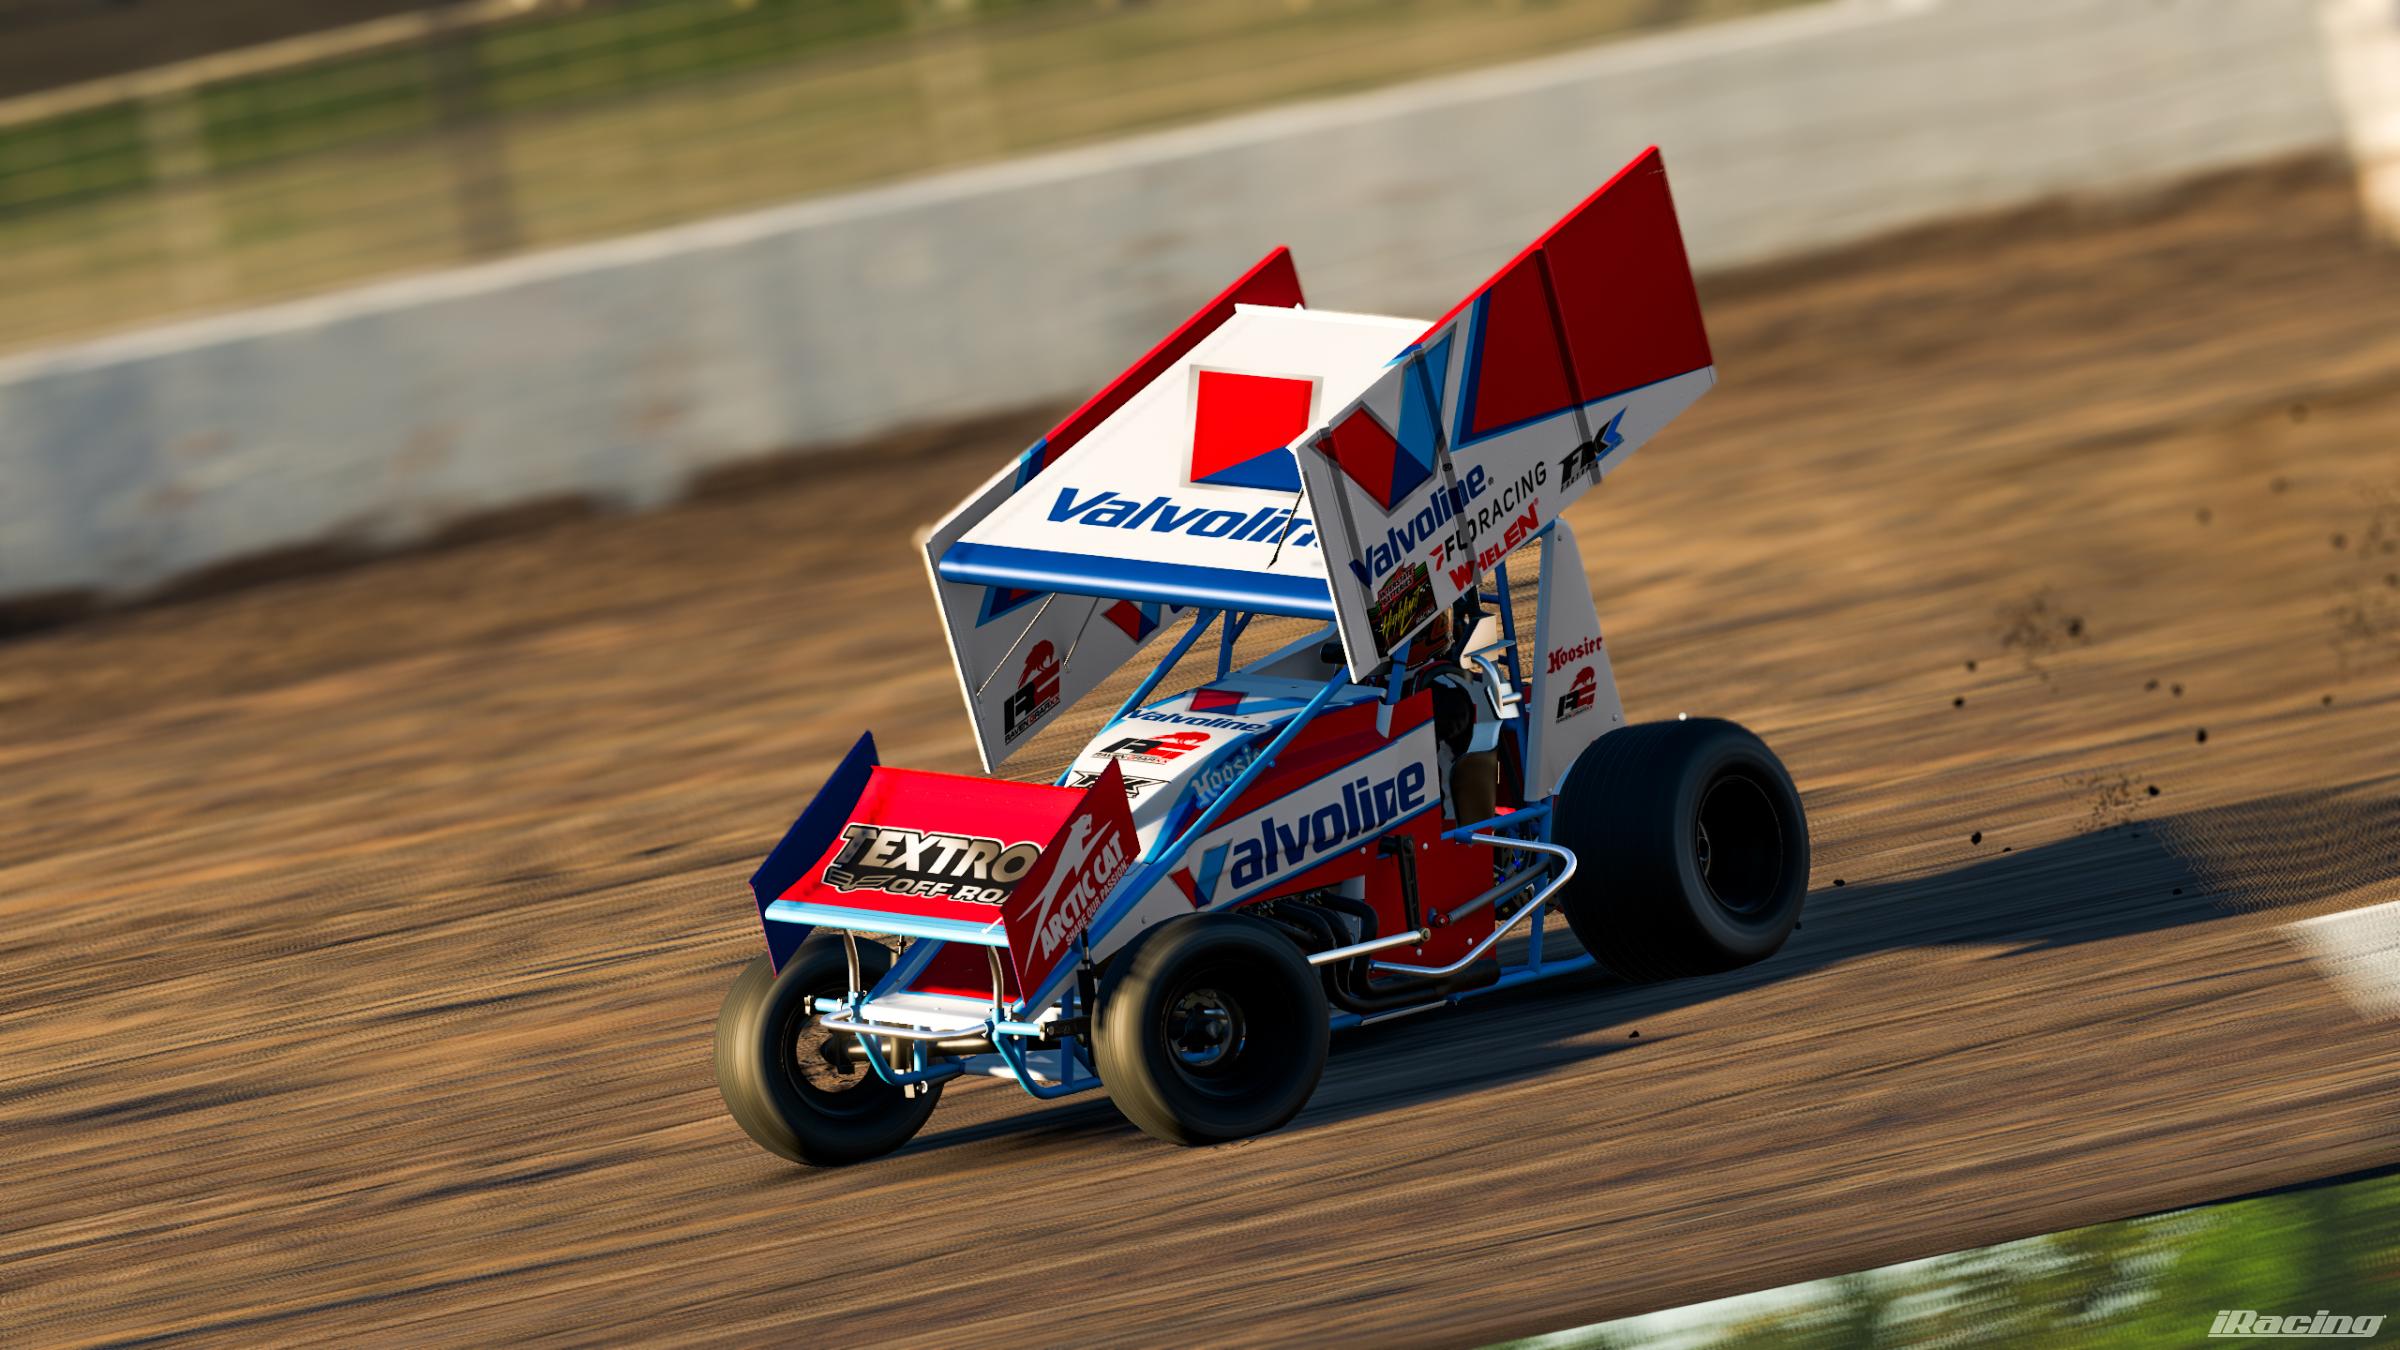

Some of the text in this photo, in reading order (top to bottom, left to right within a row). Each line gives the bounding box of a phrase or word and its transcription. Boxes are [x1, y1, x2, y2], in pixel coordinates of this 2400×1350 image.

[1047, 487, 1319, 549] Valvolin
[1349, 464, 1486, 590] Valvoline
[1547, 636, 1602, 674] Hoosier
[1128, 709, 1266, 732] Valvoline
[834, 825, 1042, 884] TEXTRO
[889, 877, 953, 898] OFF
[1040, 869, 1097, 961] ARCTIC
[1093, 830, 1124, 884] CAT
[1065, 914, 1088, 946] SHARE
[1086, 896, 1101, 919] OUR
